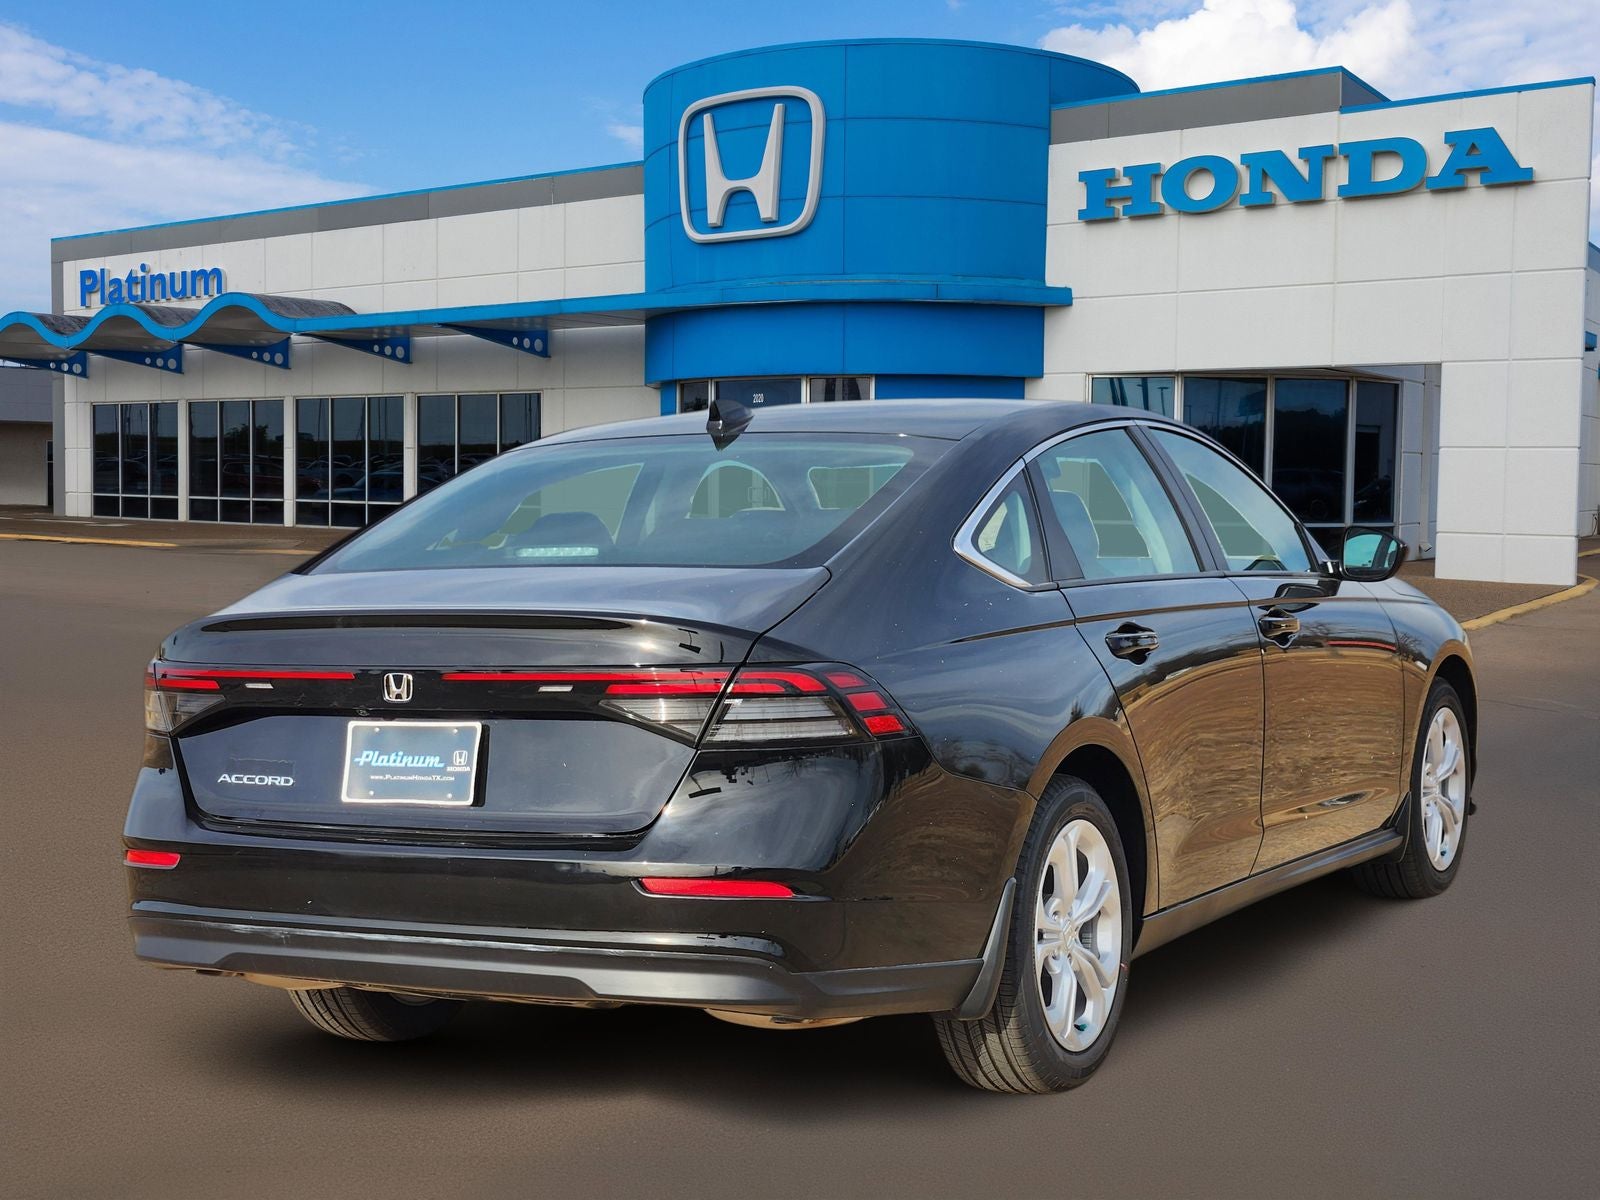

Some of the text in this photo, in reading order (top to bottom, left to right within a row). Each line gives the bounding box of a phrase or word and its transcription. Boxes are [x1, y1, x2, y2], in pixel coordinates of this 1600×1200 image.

[1078, 126, 1535, 222] HONDA
[79, 262, 226, 308] Platinum
[354, 750, 446, 768] Platinum
[217, 773, 294, 786] ACCORD
